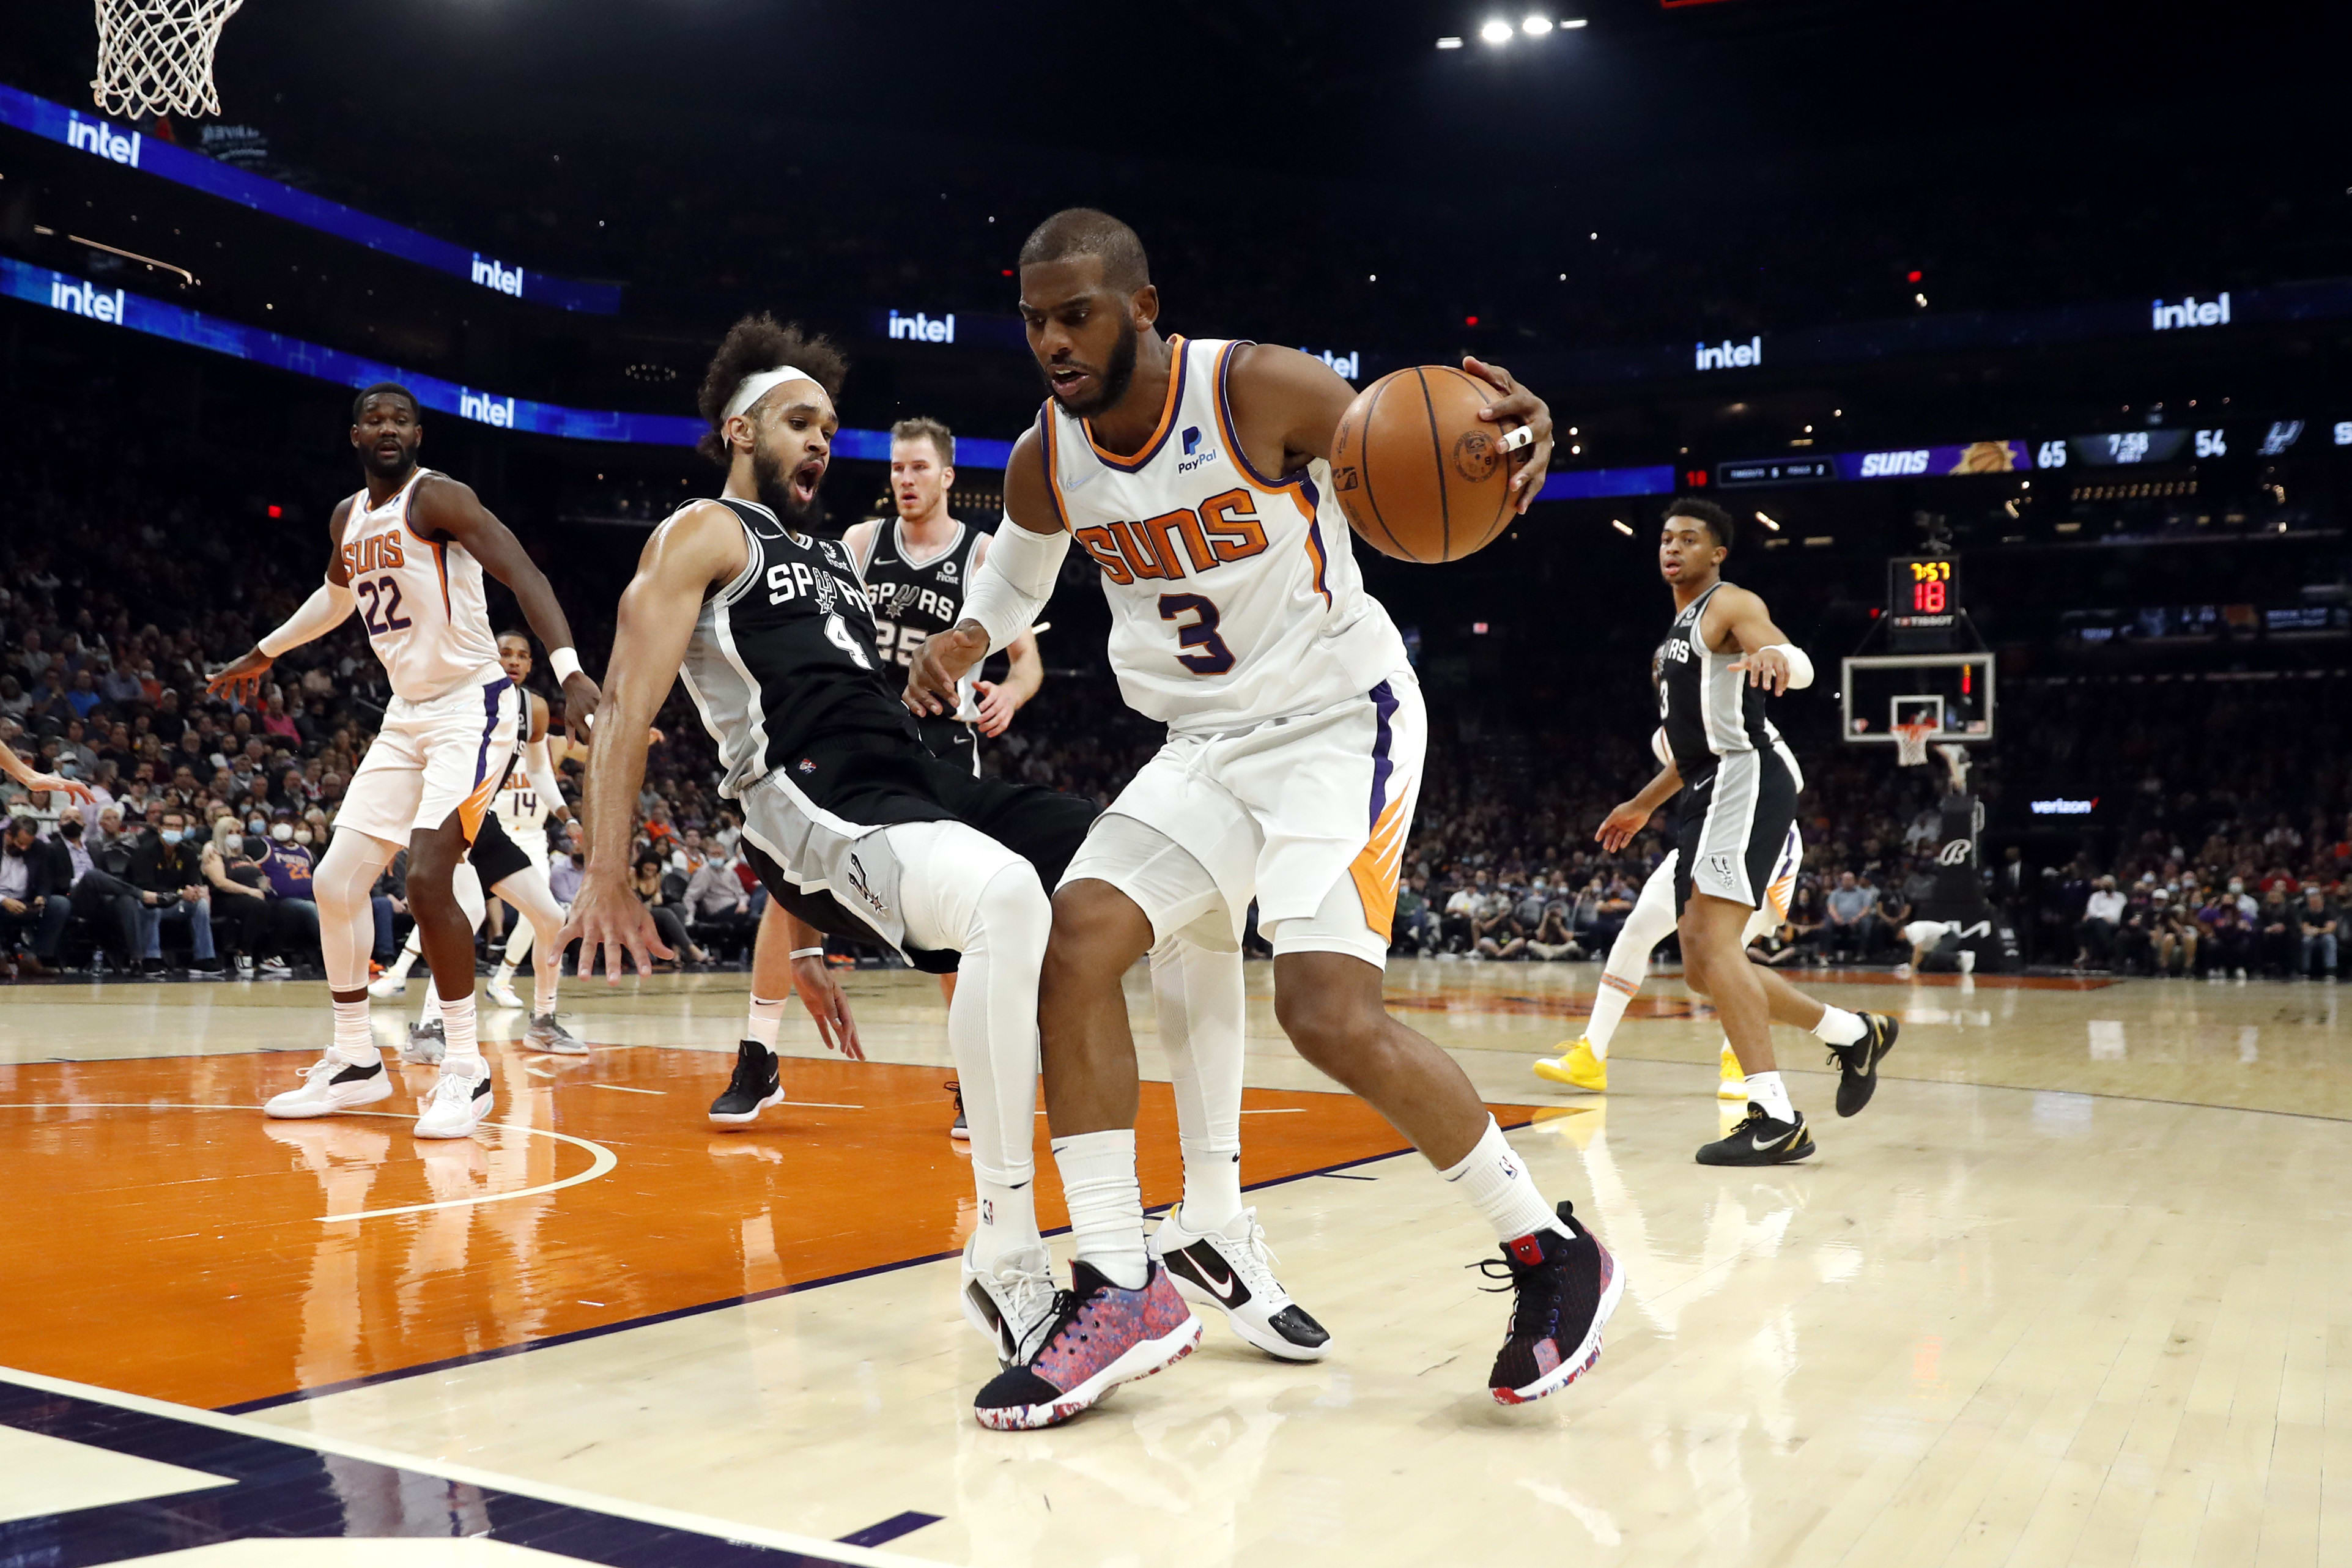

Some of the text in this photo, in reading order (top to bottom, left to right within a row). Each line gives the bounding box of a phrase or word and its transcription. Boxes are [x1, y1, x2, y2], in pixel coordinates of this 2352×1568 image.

[67, 109, 141, 168] intel
[472, 251, 523, 298] intel
[51, 271, 125, 325] intel
[2152, 292, 2231, 331] intel
[889, 309, 955, 343] intel
[1300, 347, 1358, 380] tel
[1695, 335, 1761, 371] intel
[460, 386, 515, 429] intel
[2038, 440, 2067, 469] 65
[2195, 429, 2227, 458] 54
[1178, 449, 1216, 474] PayPal
[1686, 470, 1707, 487] 18
[1860, 449, 1930, 478] SUNS
[1074, 487, 1270, 585] SUNS
[342, 529, 405, 582] SUNS
[1910, 561, 1950, 582] 7:57
[936, 571, 959, 585] Frost
[358, 575, 413, 636] 22
[1914, 580, 1946, 613] 18
[824, 611, 875, 670] 4
[875, 619, 930, 667] 25
[1157, 592, 1236, 676] 3
[514, 792, 537, 817] 14
[2030, 797, 2091, 814] verizon
[285, 863, 312, 881] 22
